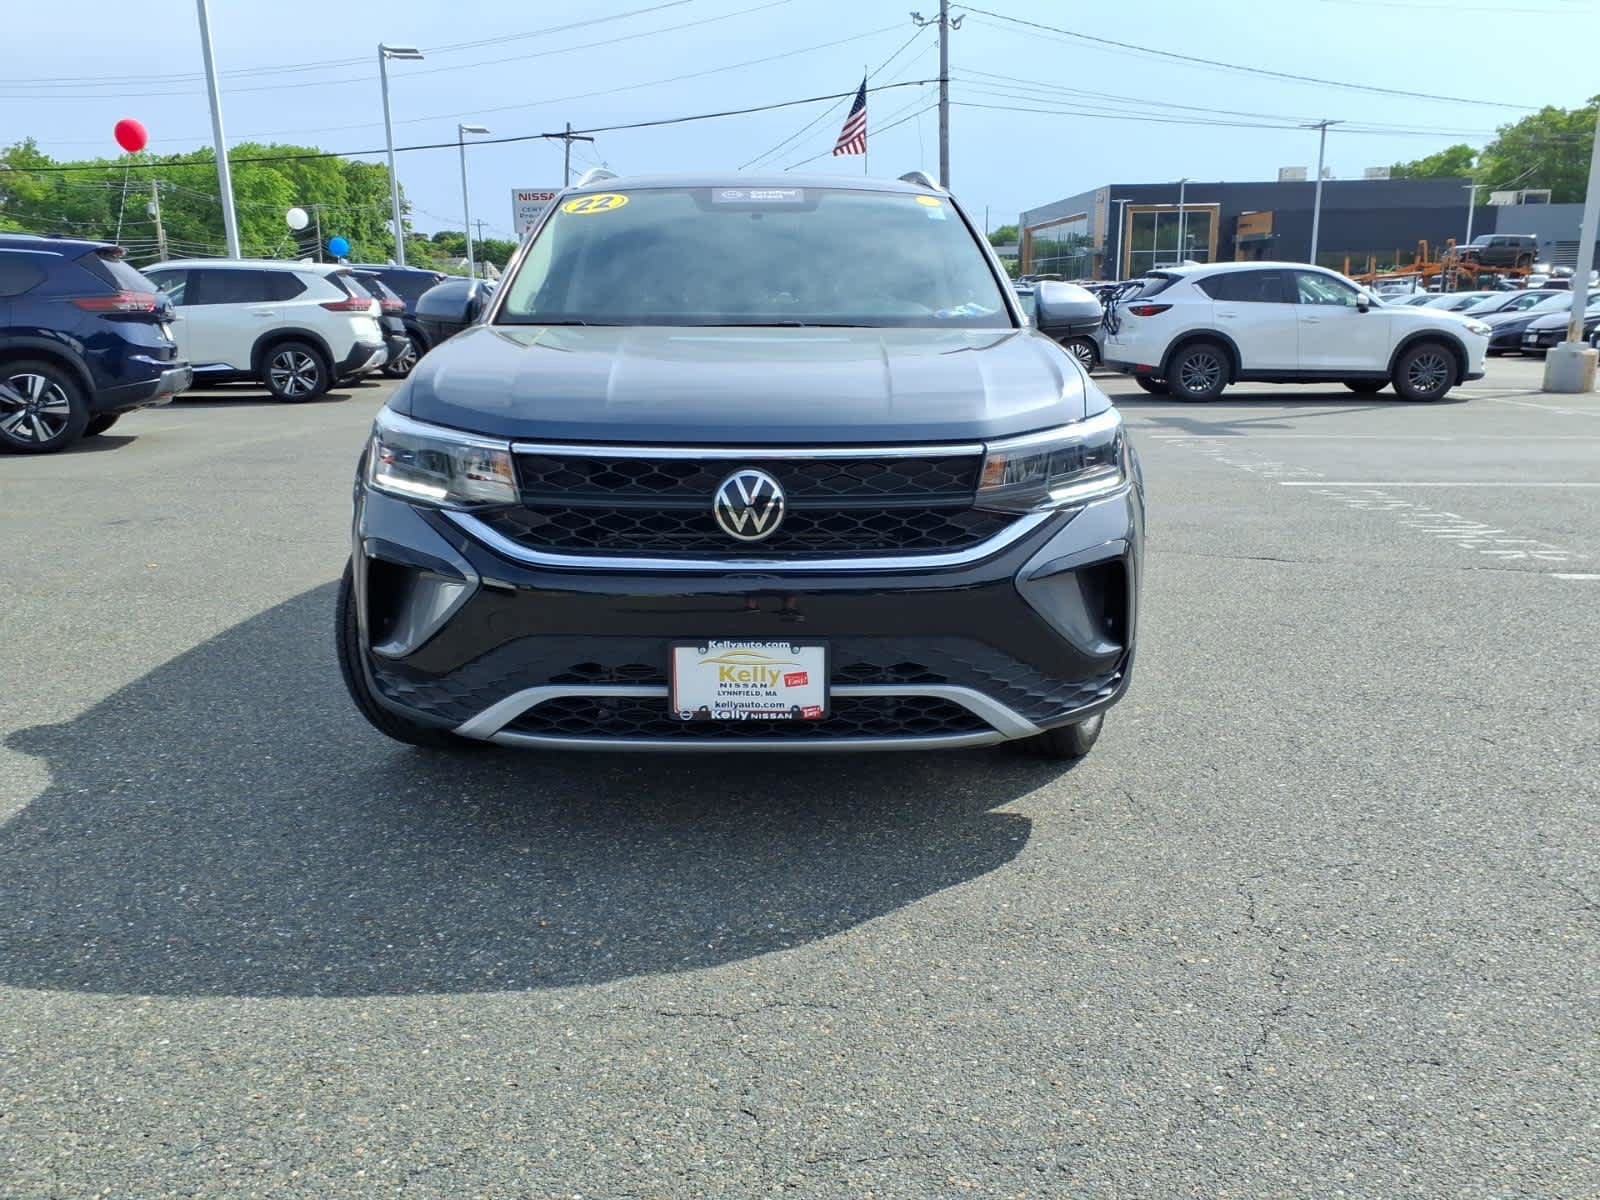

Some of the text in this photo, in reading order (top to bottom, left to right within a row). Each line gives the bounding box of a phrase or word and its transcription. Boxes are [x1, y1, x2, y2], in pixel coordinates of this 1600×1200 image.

[518, 192, 556, 201] NISSA
[574, 196, 614, 211] 22
[708, 640, 791, 650] Kellyauto.com
[719, 665, 782, 688] Kelly
[714, 701, 785, 709] kellyauto.com
[711, 710, 749, 720] Kelly
